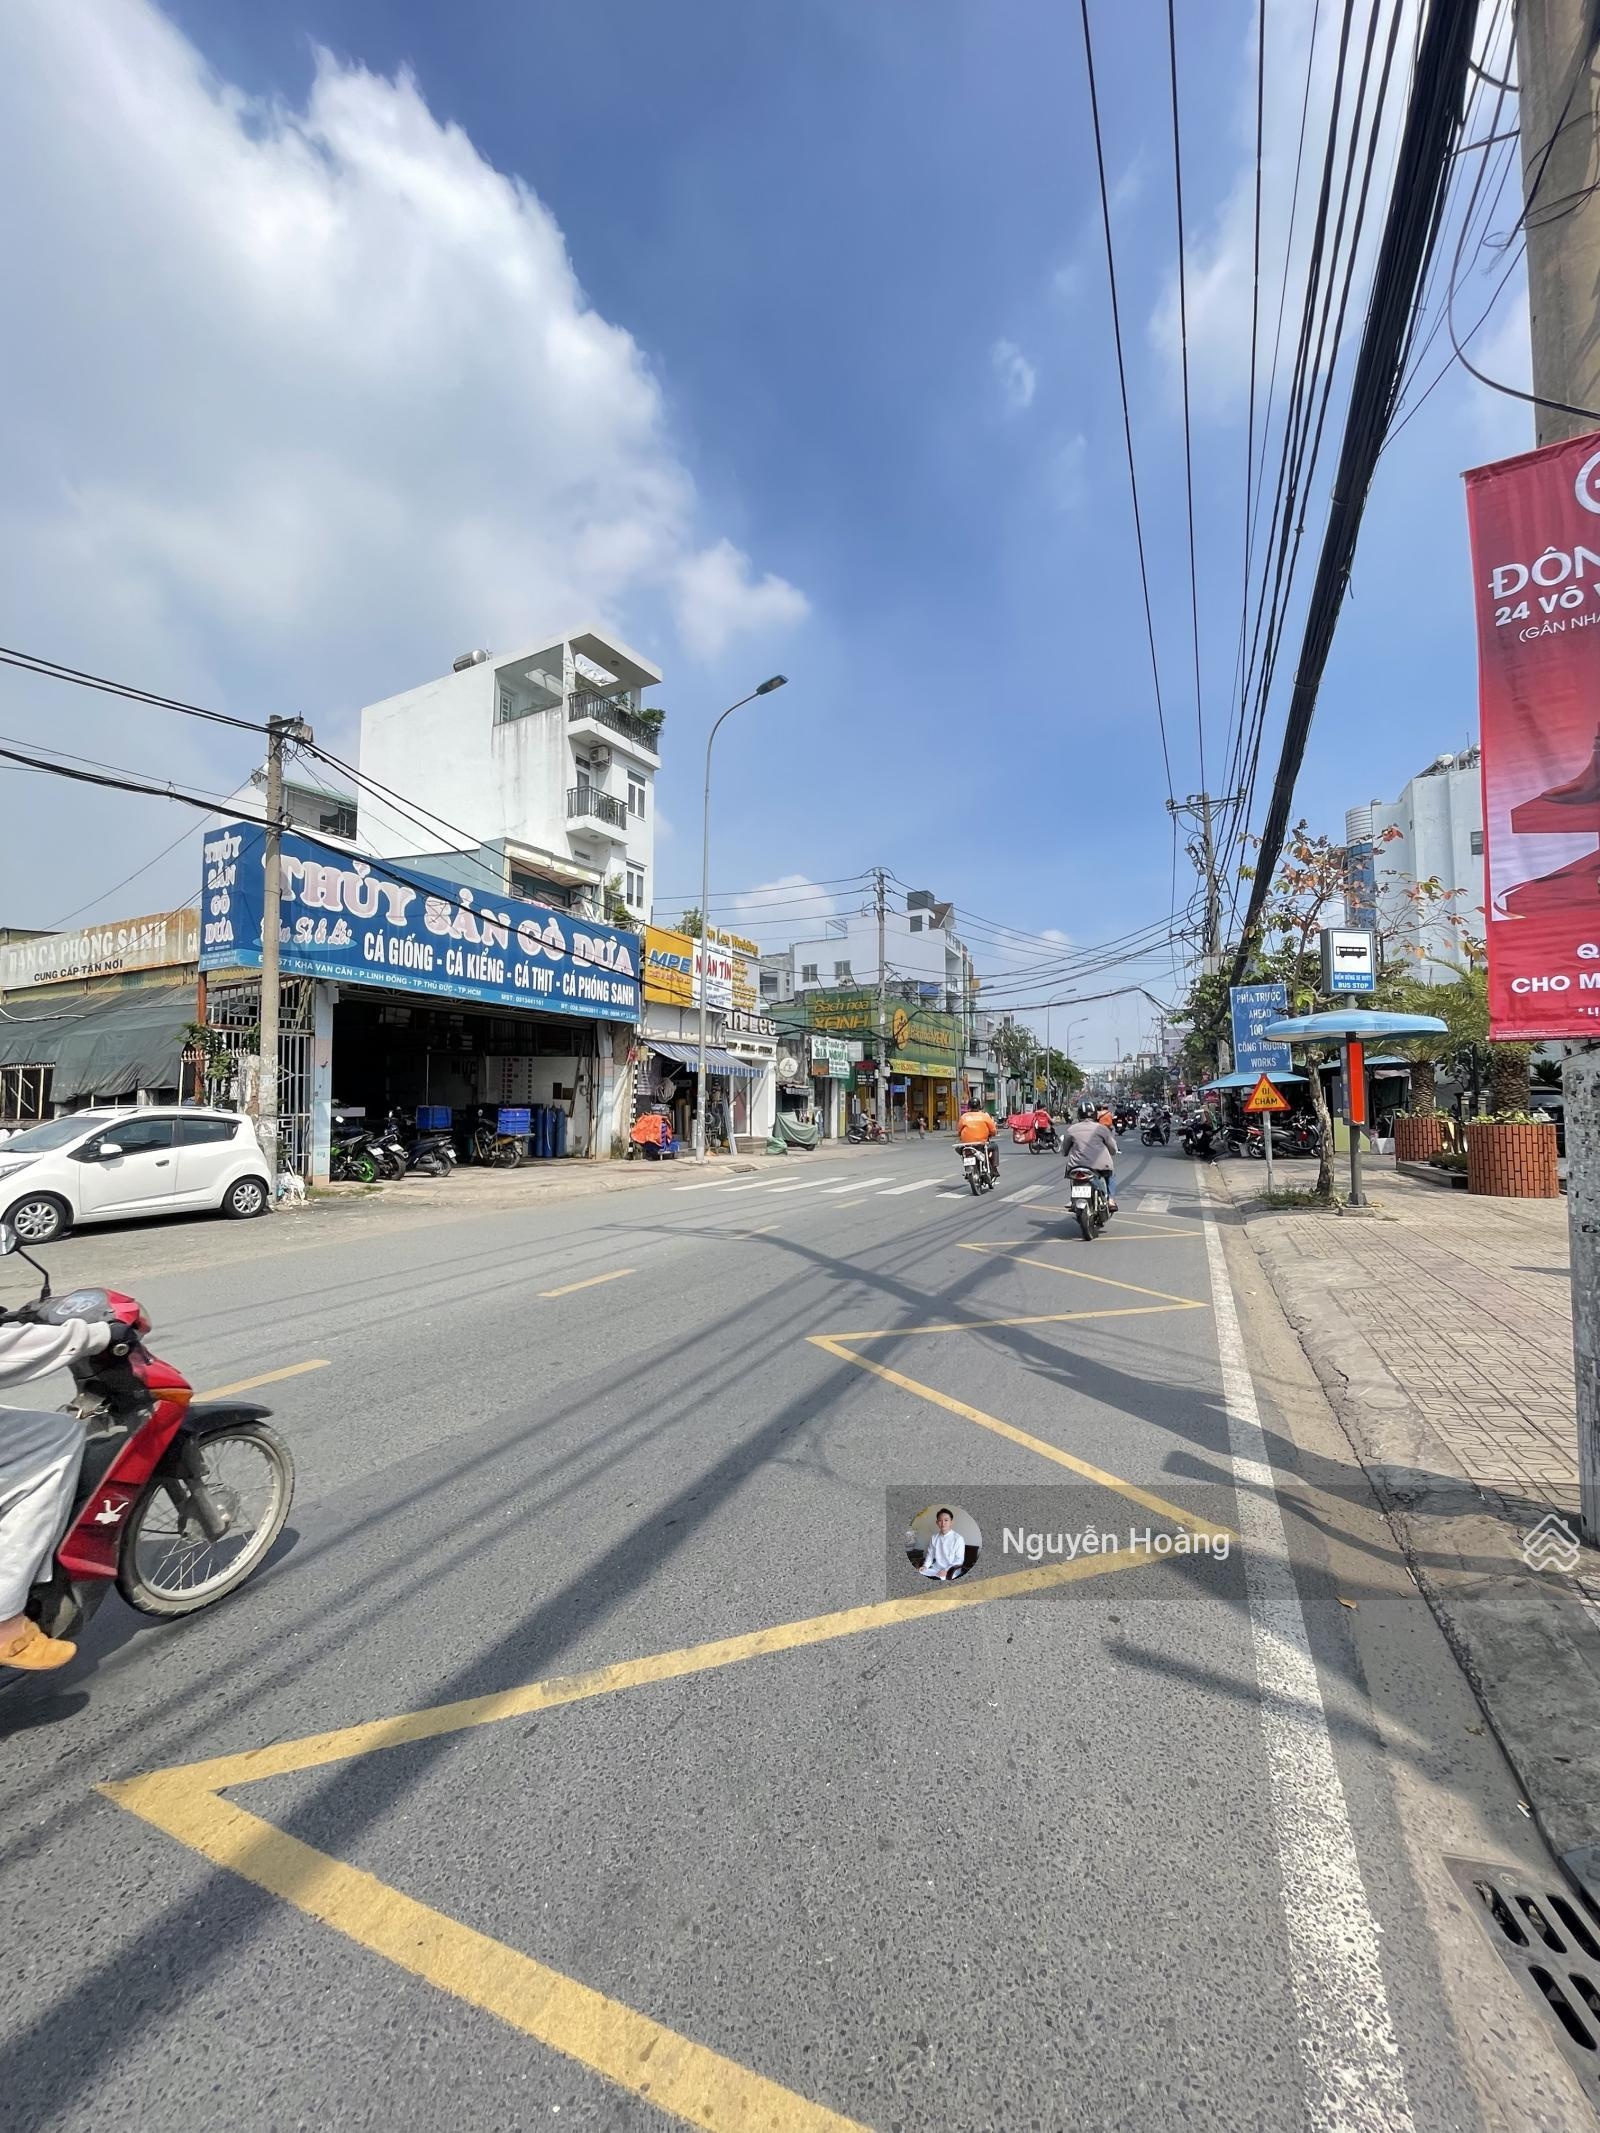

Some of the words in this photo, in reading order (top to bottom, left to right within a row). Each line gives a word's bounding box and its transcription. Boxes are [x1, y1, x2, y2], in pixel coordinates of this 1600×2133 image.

[1495, 601, 1530, 626] 24
[1538, 585, 1584, 614] VÕ
[262, 853, 416, 926] THỦY
[424, 888, 511, 949] SẢN
[517, 918, 566, 961] GÒ
[59, 930, 113, 966] PHÓNG
[117, 921, 167, 954] SANH
[34, 970, 58, 982] CUNG
[60, 964, 79, 978] CẤP
[81, 963, 102, 975] TẬN
[104, 959, 123, 970] NƠI
[295, 960, 313, 970] KHA
[364, 929, 385, 962] CÁ
[388, 933, 433, 971] GIỐNG
[445, 946, 464, 977] CÁ
[467, 947, 504, 984] KIỂNG
[514, 960, 529, 989] CÁ
[532, 966, 554, 997] THỊT
[562, 970, 577, 997] CÁ
[578, 973, 610, 1003] PHÓNG
[611, 985, 634, 1007] SANH
[649, 949, 692, 973] MPE
[696, 954, 717, 976] NÂN
[1511, 975, 1570, 993] CHO
[1248, 1009, 1271, 1019] AHEAD
[1249, 1024, 1263, 1037] 100
[1251, 1057, 1277, 1068] WORKS
